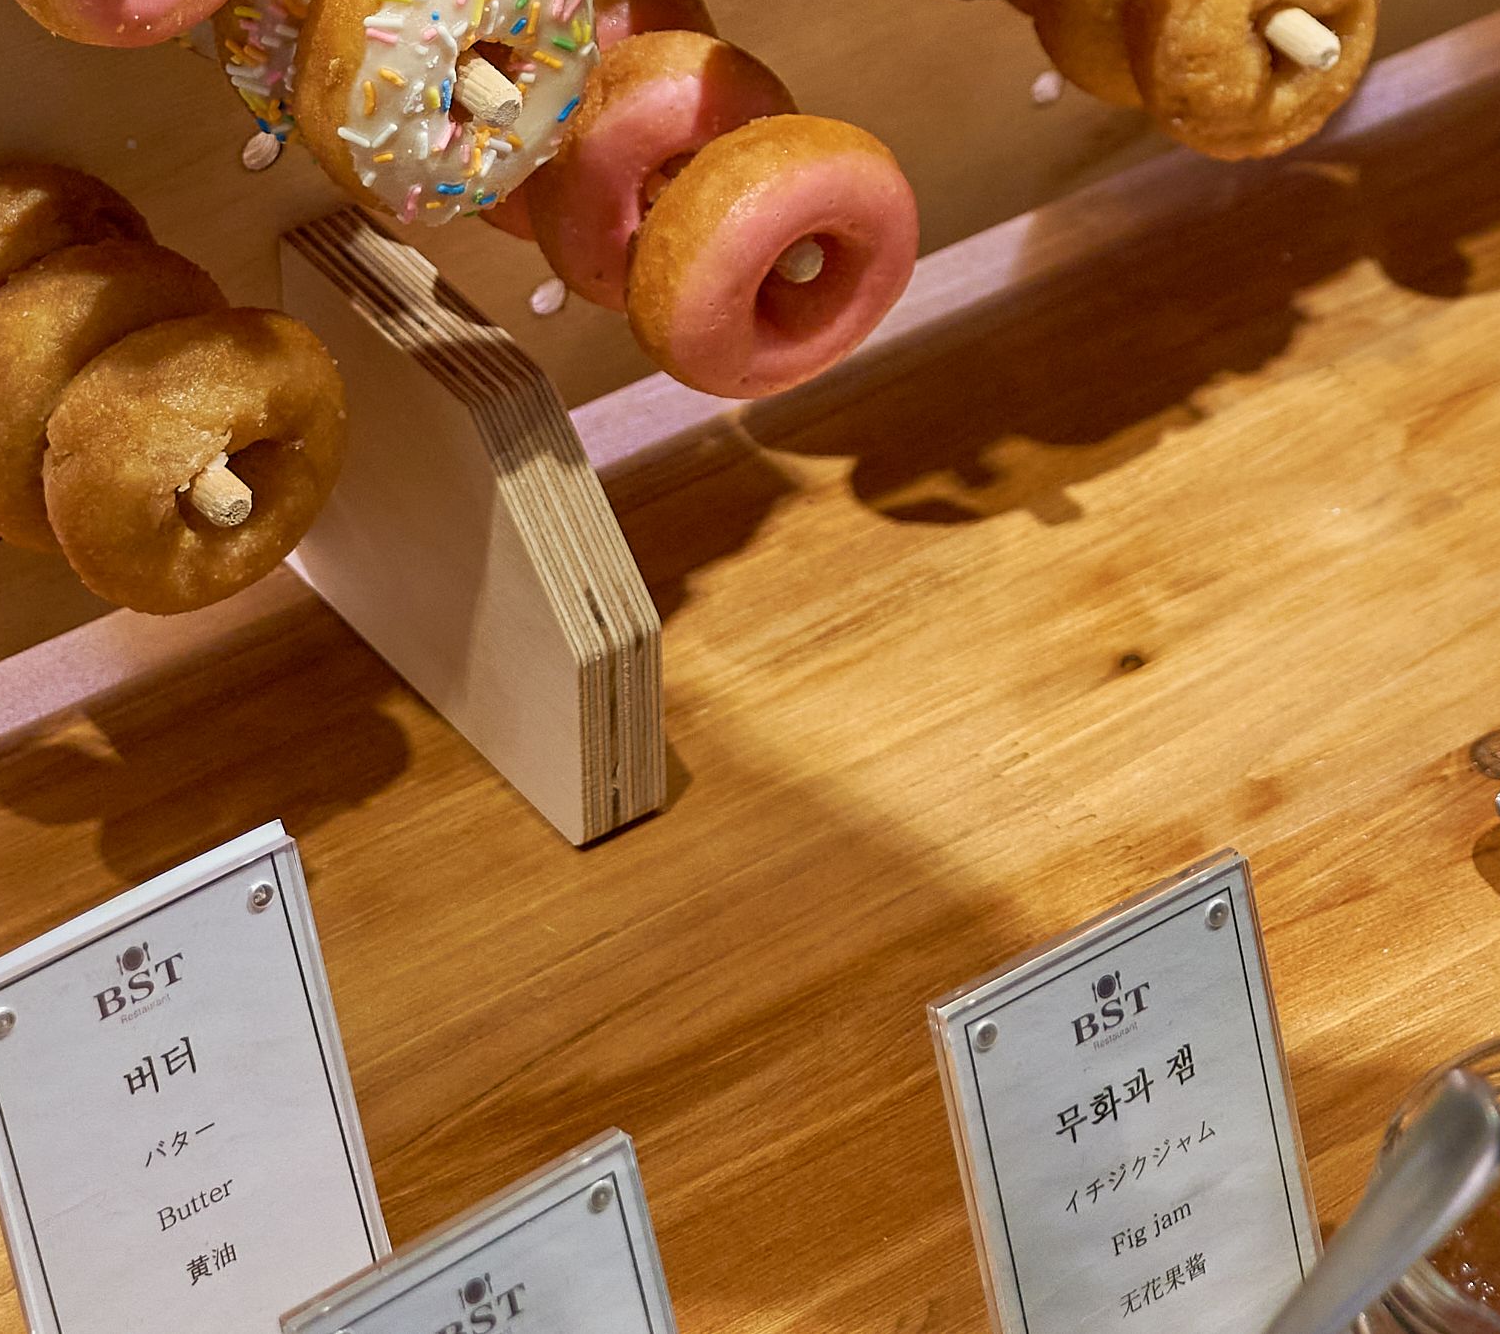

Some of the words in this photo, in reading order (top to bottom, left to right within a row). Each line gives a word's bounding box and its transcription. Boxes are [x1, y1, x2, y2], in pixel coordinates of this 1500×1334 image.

[93, 952, 184, 1022] BST
[1070, 981, 1150, 1046] BST
[123, 1036, 197, 1095] 버터
[1055, 1067, 1154, 1143] 무화과
[1166, 1043, 1196, 1085] 잼
[145, 1122, 215, 1168] バター
[1066, 1120, 1216, 1213] イチジクジャム
[157, 1179, 233, 1232] Butter
[1111, 1226, 1148, 1256] Fig
[1155, 1203, 1192, 1237] jam
[186, 1242, 237, 1286] 黄油
[1120, 1252, 1207, 1319] 无花果酱
[433, 1283, 526, 1334] ST
